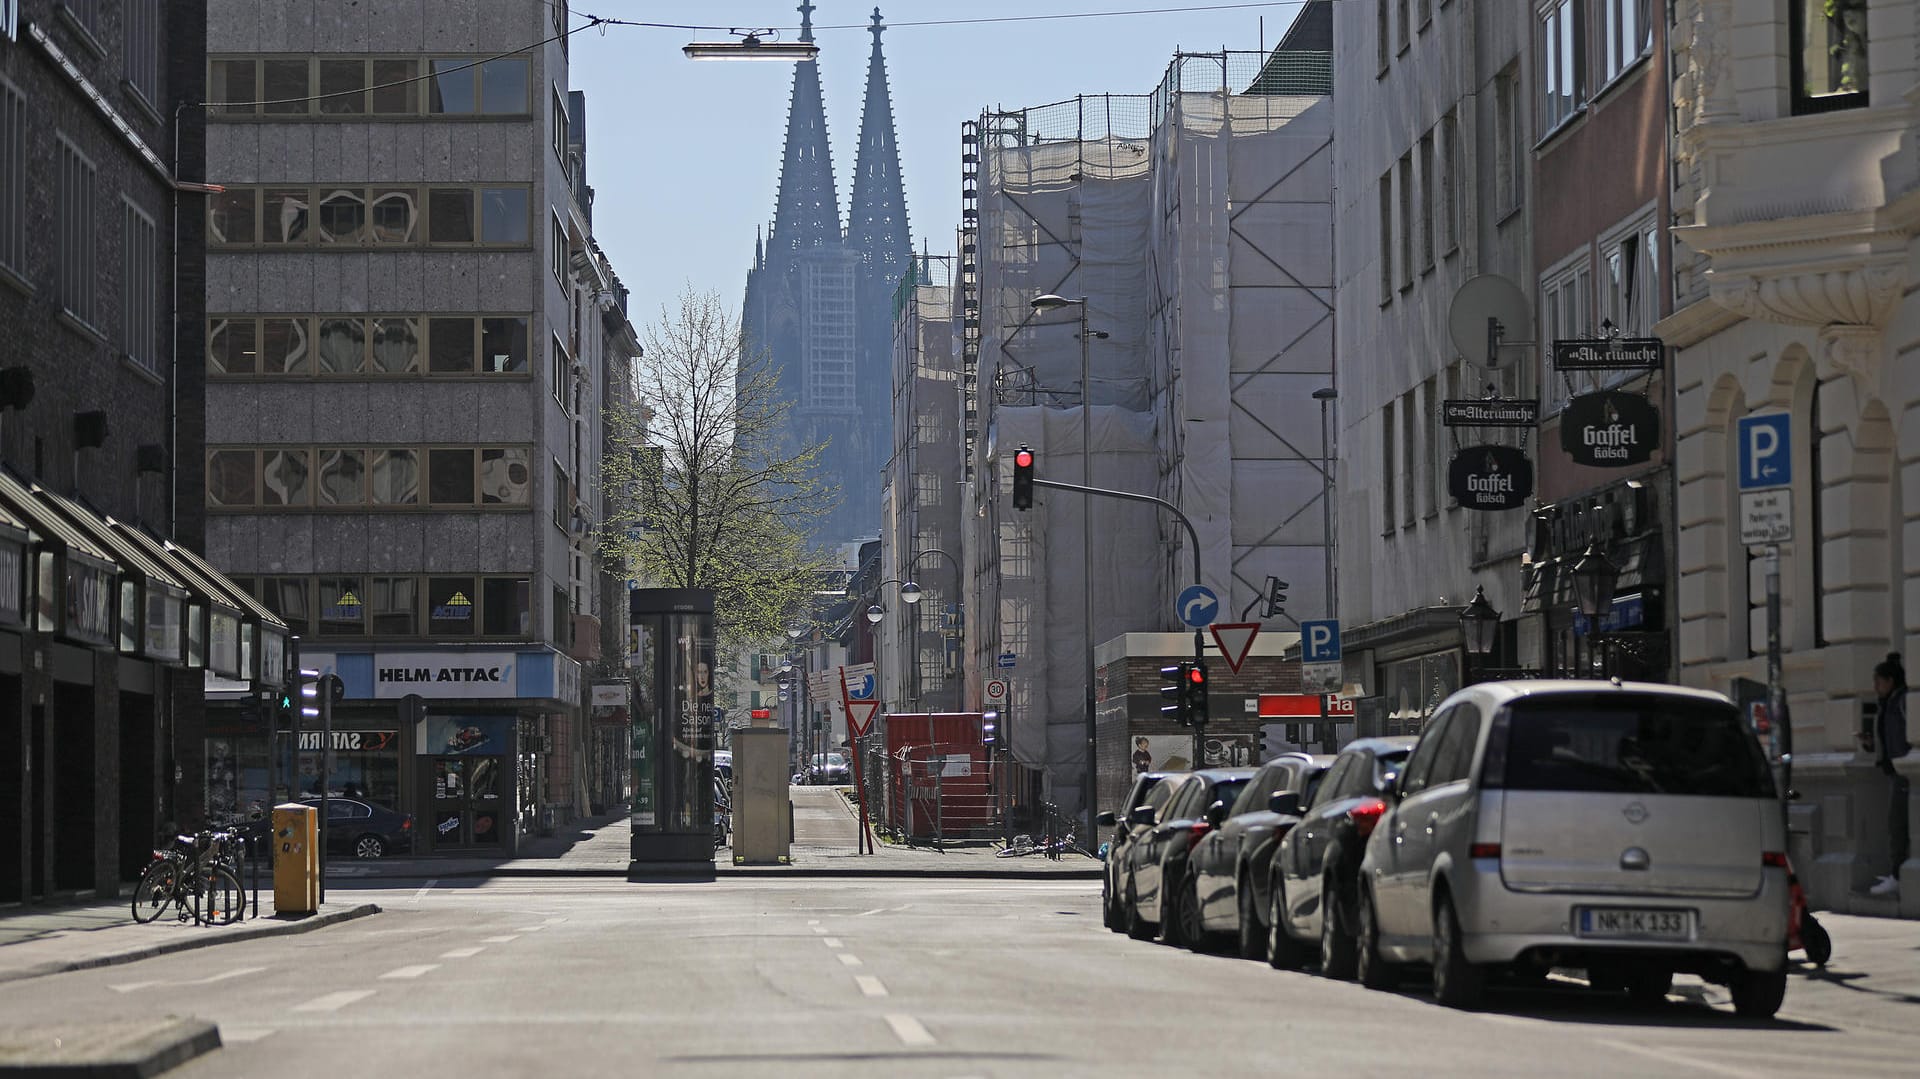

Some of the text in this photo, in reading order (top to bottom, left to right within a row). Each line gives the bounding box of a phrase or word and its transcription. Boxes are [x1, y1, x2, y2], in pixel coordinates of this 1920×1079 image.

[1583, 424, 1638, 446] Gaffel
[1594, 446, 1628, 459] Kölsch
[1751, 424, 1778, 479] P
[1468, 473, 1514, 492] Gaffel
[1476, 492, 1505, 504] Kölsch
[1311, 625, 1331, 657] P
[991, 685, 1001, 694] 30
[682, 700, 698, 712] Die
[1599, 912, 1681, 931] NK K 133
